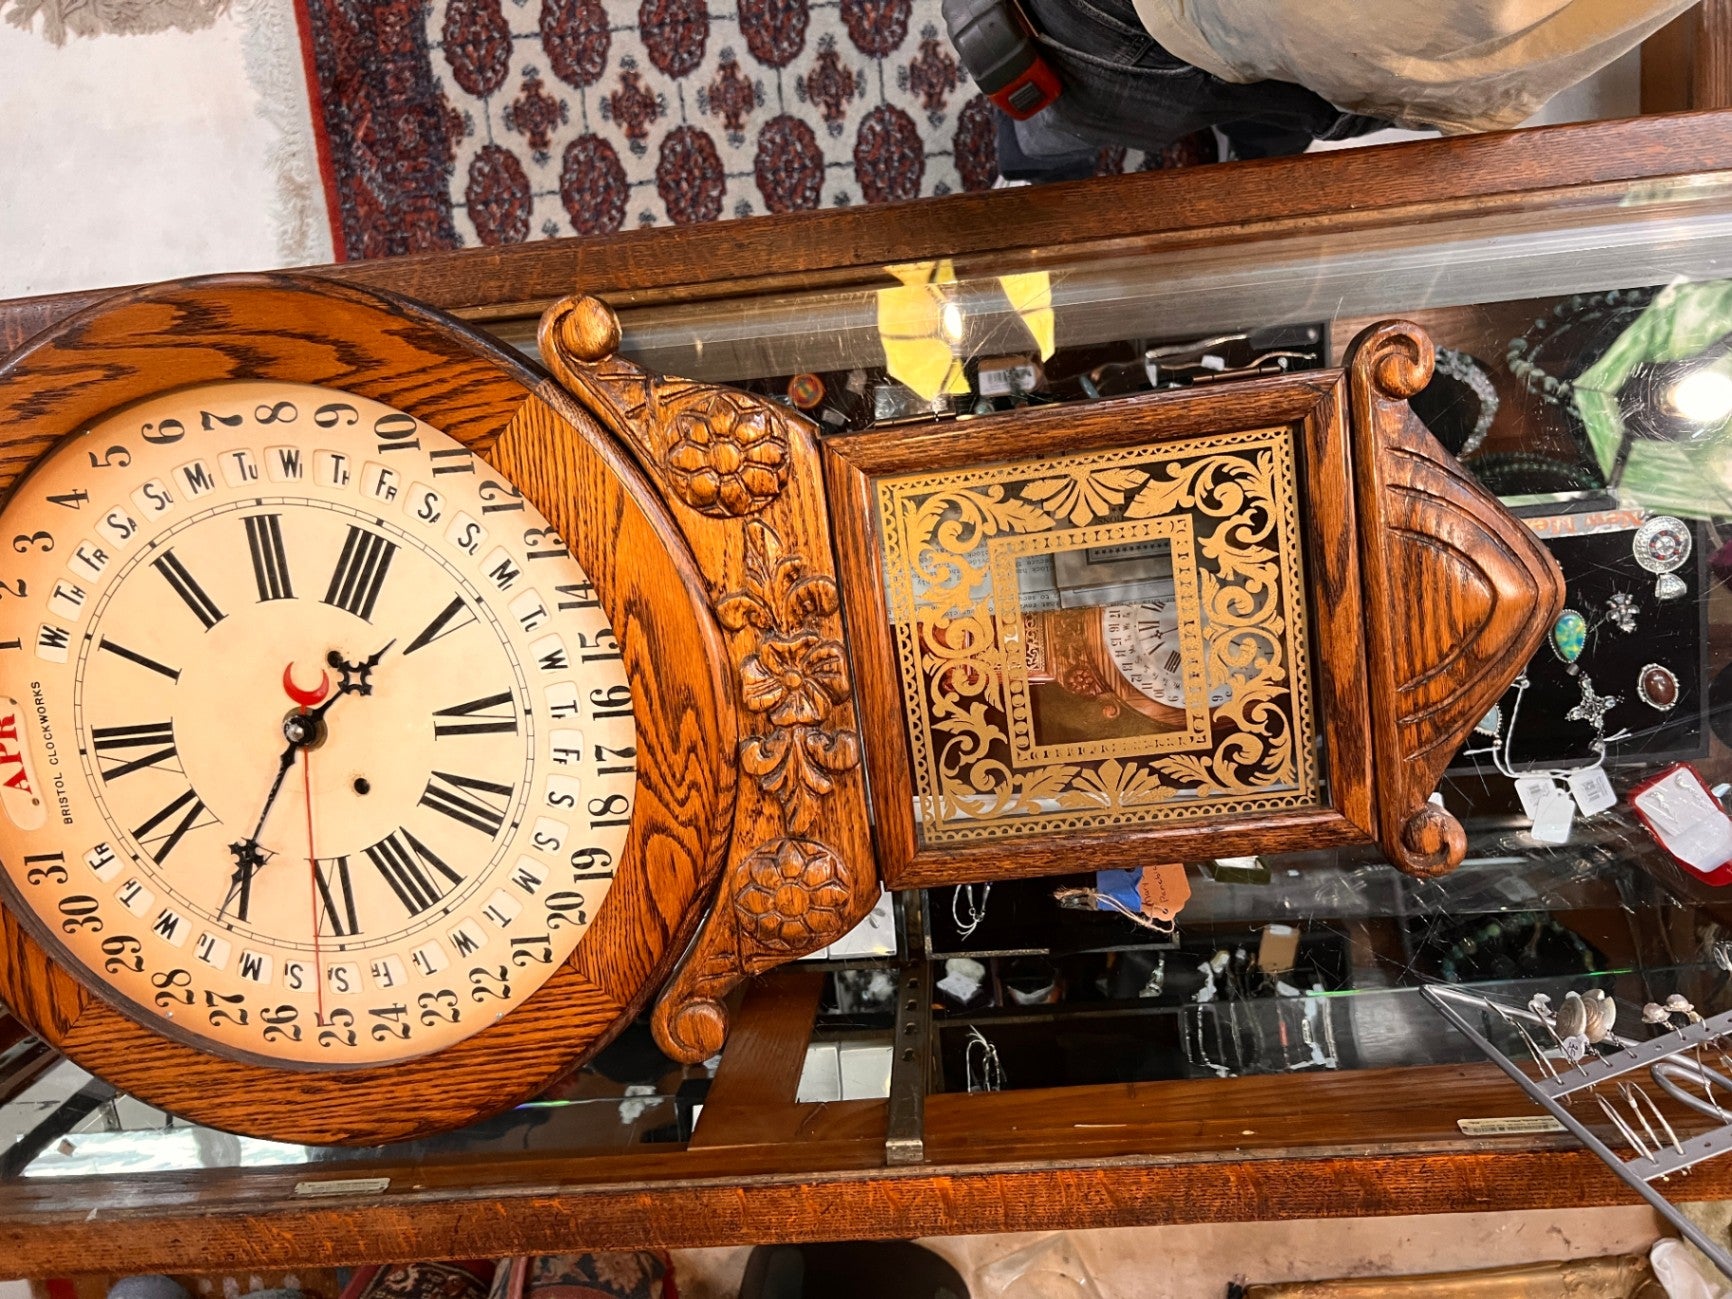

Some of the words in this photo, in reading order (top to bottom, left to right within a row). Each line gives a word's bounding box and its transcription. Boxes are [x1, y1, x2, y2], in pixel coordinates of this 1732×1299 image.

[201, 411, 242, 430] 7
[254, 401, 298, 425] 8
[314, 403, 359, 428] 9
[142, 419, 184, 444] 6
[373, 412, 421, 454] 10
[89, 446, 130, 467] 5
[429, 447, 476, 478] 11
[47, 490, 88, 509] 4
[478, 479, 525, 515] 12
[13, 532, 54, 552] 3
[239, 514, 298, 603] III
[523, 525, 570, 561] 13
[149, 546, 229, 632] II
[319, 524, 401, 625] IIII
[554, 578, 602, 611] 14
[403, 592, 480, 655] V
[98, 634, 181, 685] I
[577, 628, 624, 664] 15
[432, 687, 518, 740] VI
[589, 685, 633, 721] 16
[31, 681, 58, 765] CLOCKWORKS
[91, 717, 186, 786] XII
[594, 744, 638, 776] 17
[53, 772, 73, 825] BRISTOL
[416, 771, 515, 842] VII
[587, 794, 631, 830] 18
[129, 784, 223, 869] XI
[24, 852, 67, 885] 31
[360, 826, 467, 918] VIII
[571, 848, 615, 883] 19
[304, 855, 363, 937] IX
[545, 892, 586, 929] 20
[59, 896, 102, 933] 30
[102, 936, 144, 973] 29
[511, 934, 552, 966] 21
[151, 968, 195, 1009] 28
[469, 966, 510, 1002] 22
[205, 991, 248, 1026] 27
[261, 1005, 301, 1041] 26
[369, 1004, 410, 1041] 24
[418, 990, 459, 1026] 23
[315, 1009, 356, 1047] 25
